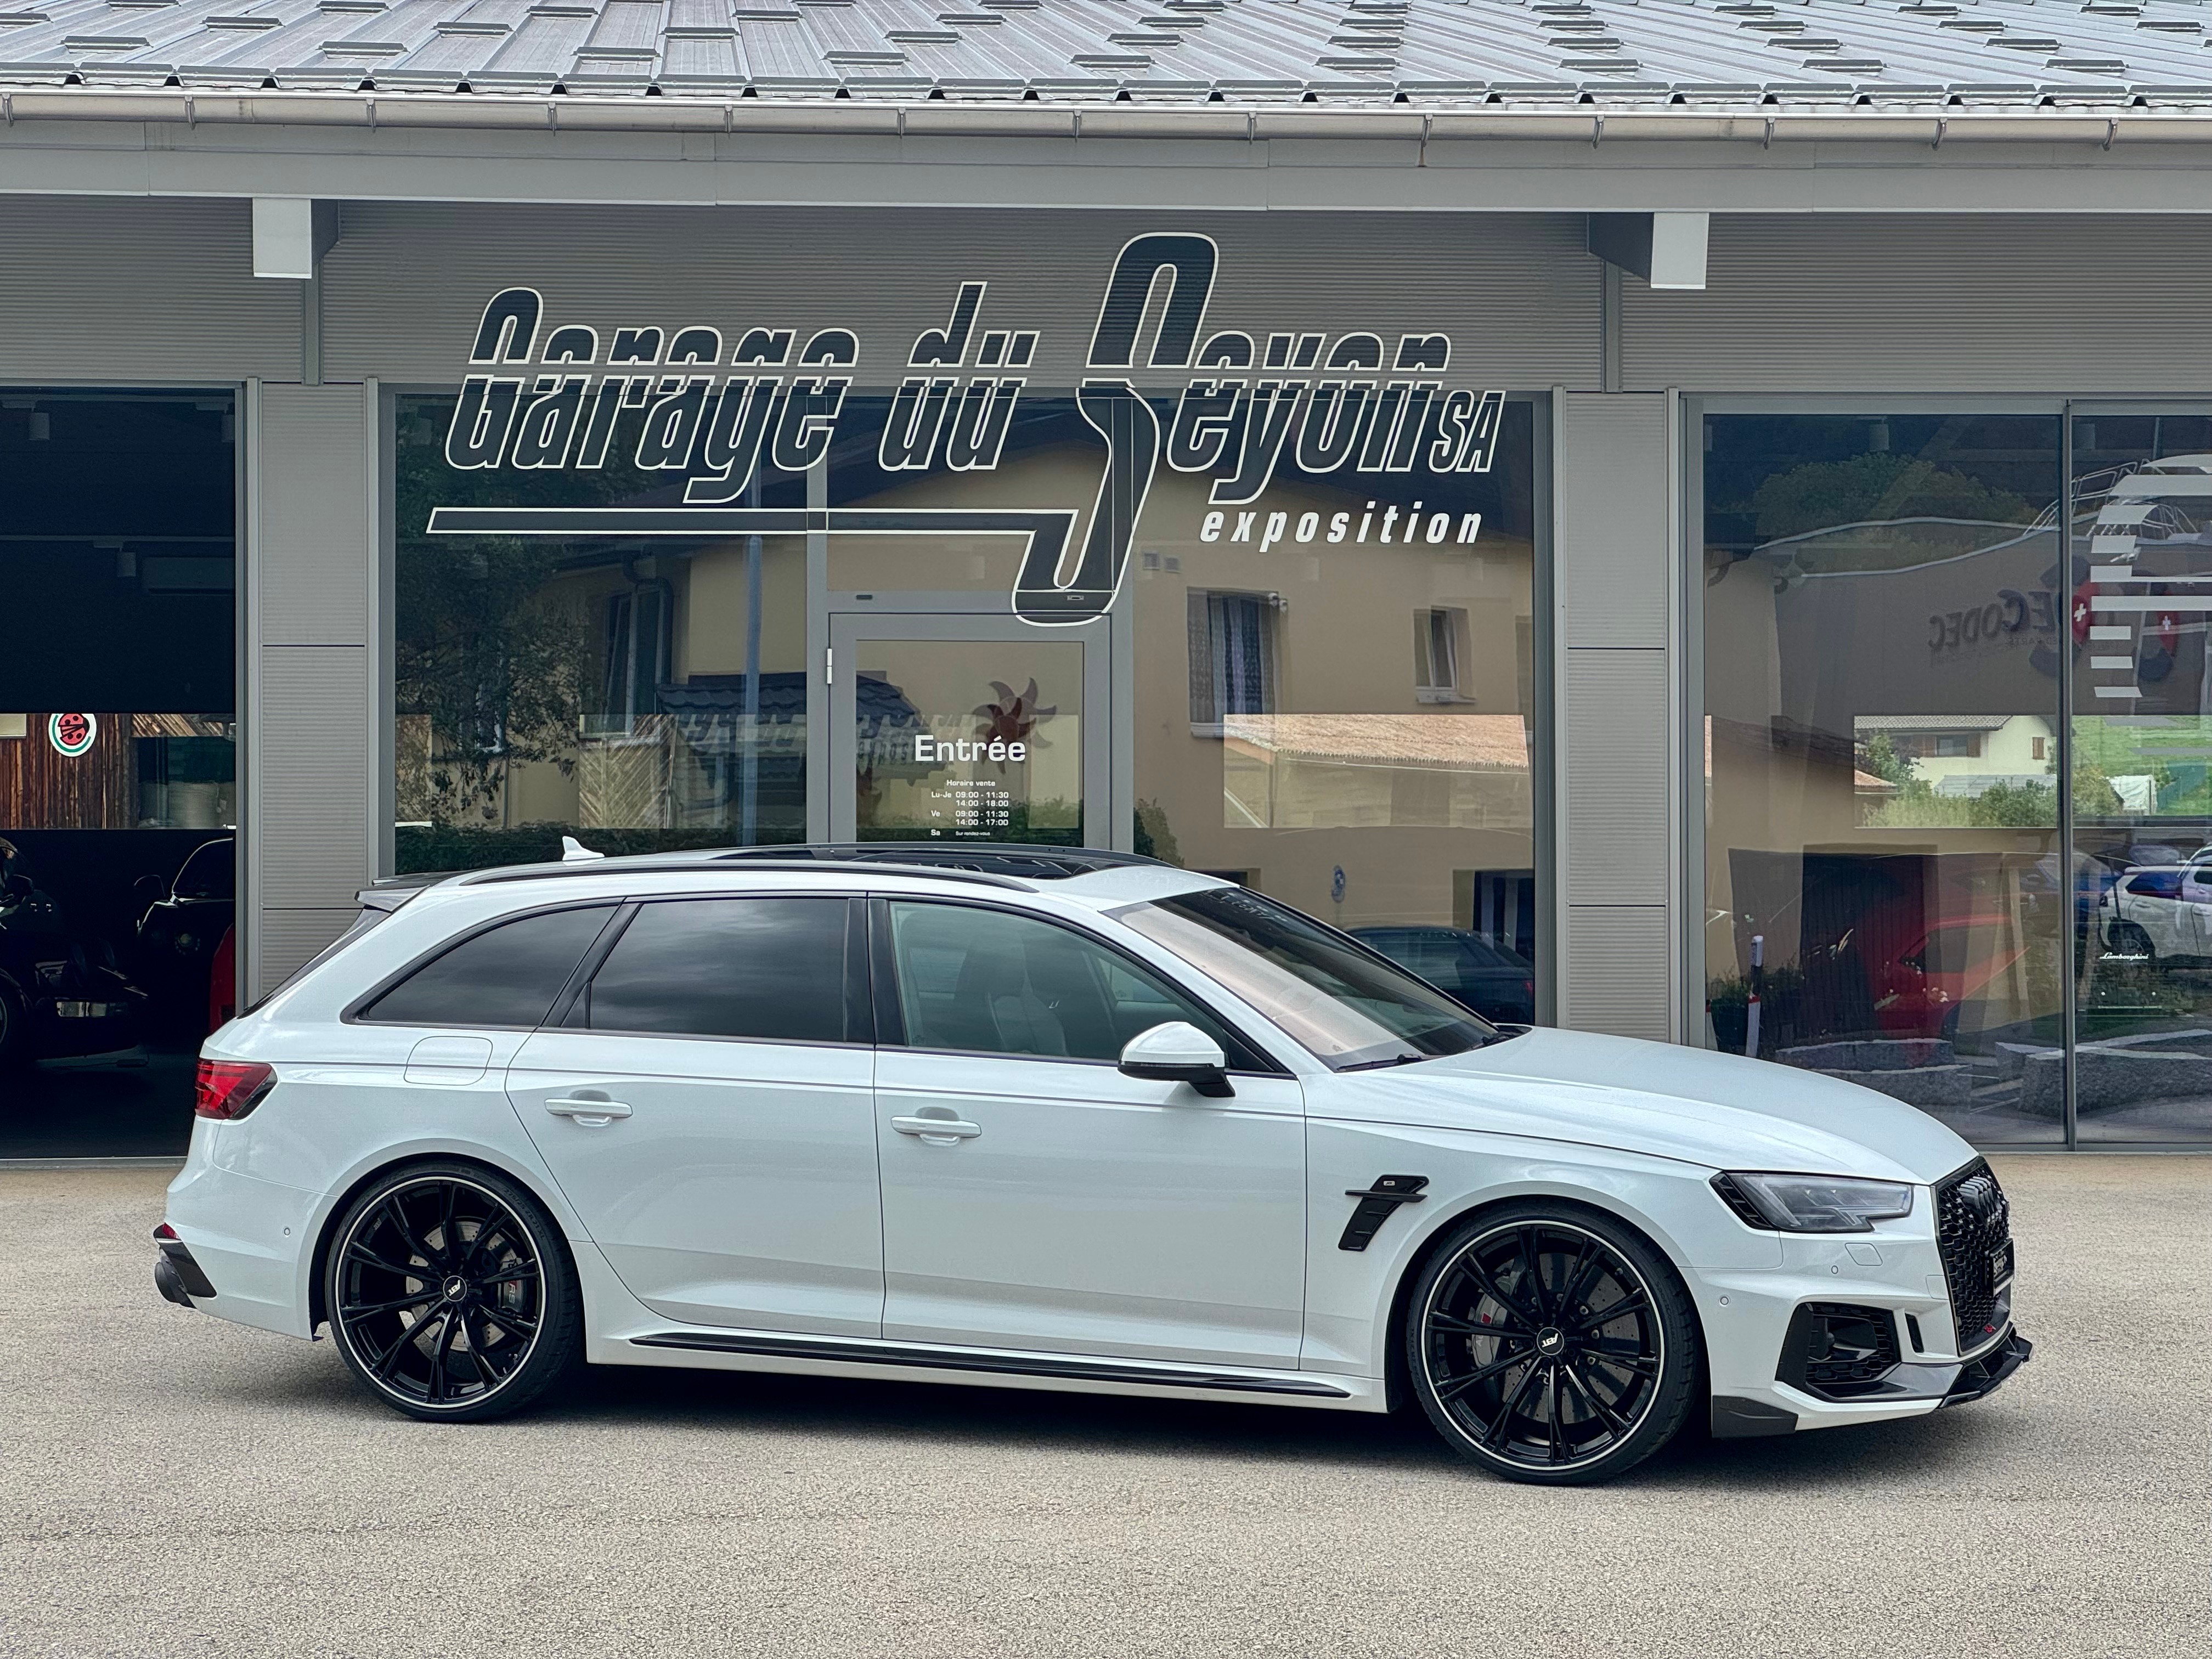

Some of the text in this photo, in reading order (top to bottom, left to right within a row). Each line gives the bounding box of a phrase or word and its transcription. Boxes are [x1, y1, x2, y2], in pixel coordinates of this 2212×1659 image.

[445, 286, 860, 504] Garage
[878, 281, 1040, 471] du
[1428, 390, 1506, 473] SA
[1200, 501, 1482, 552] exposition
[915, 735, 1026, 761] Entrée
[2099, 952, 2149, 961] Lamborghini
[509, 1283, 516, 1304] RS
